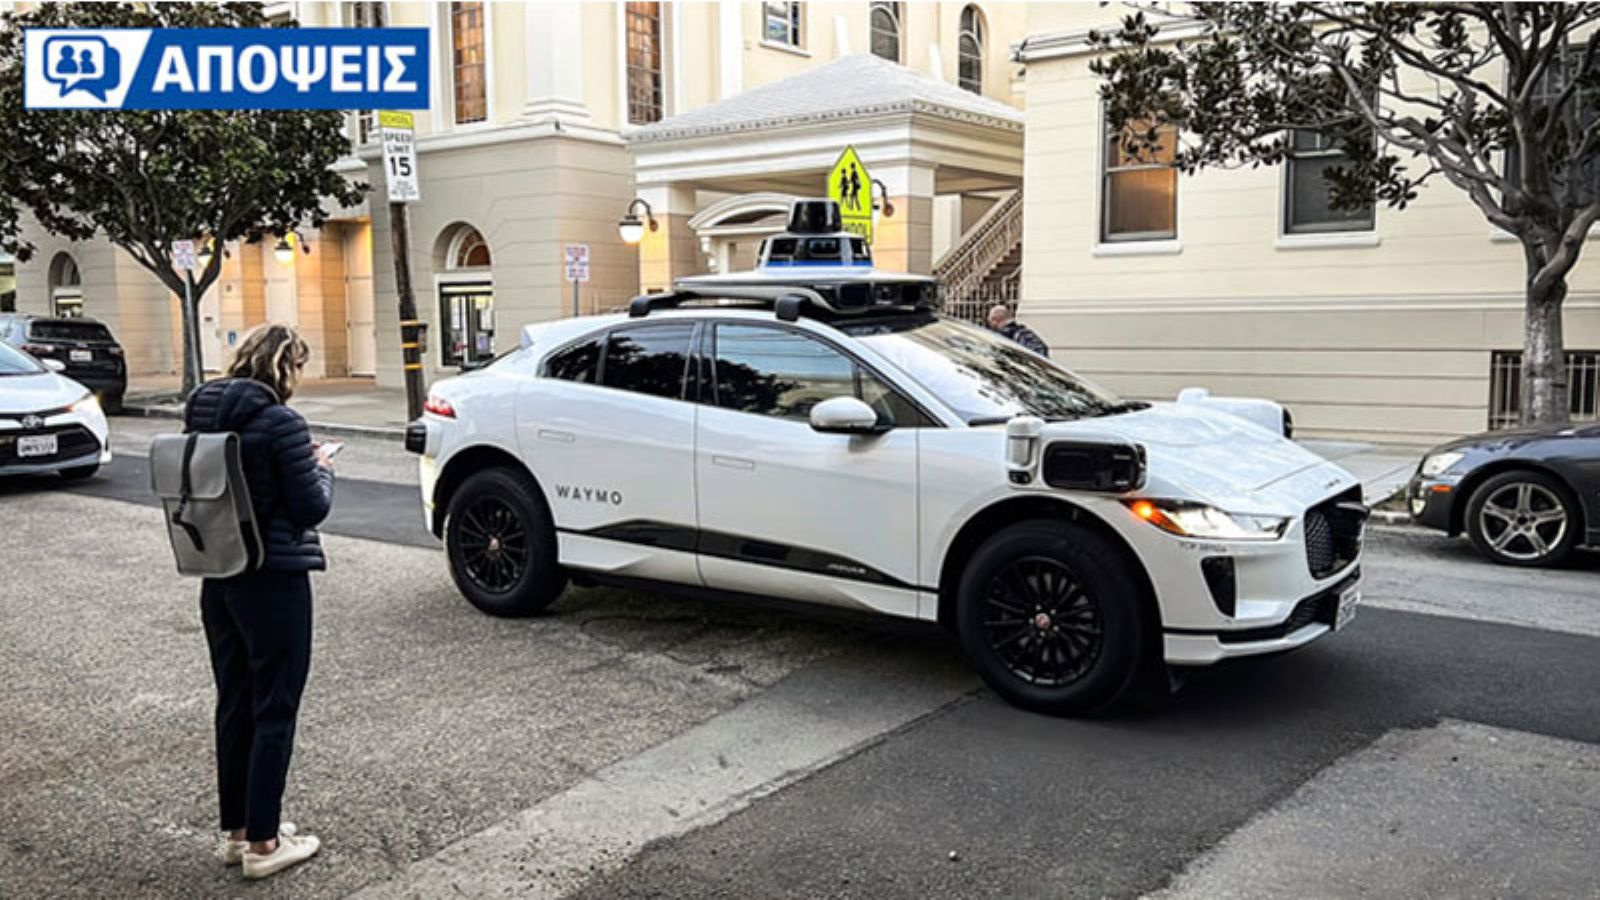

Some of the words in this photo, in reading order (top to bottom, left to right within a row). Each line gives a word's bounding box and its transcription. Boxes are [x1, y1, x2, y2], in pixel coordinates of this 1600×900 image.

[384, 132, 412, 142] SPEED
[387, 145, 410, 154] LIMIT
[390, 156, 412, 177] 15
[555, 484, 622, 506] WAYMO
